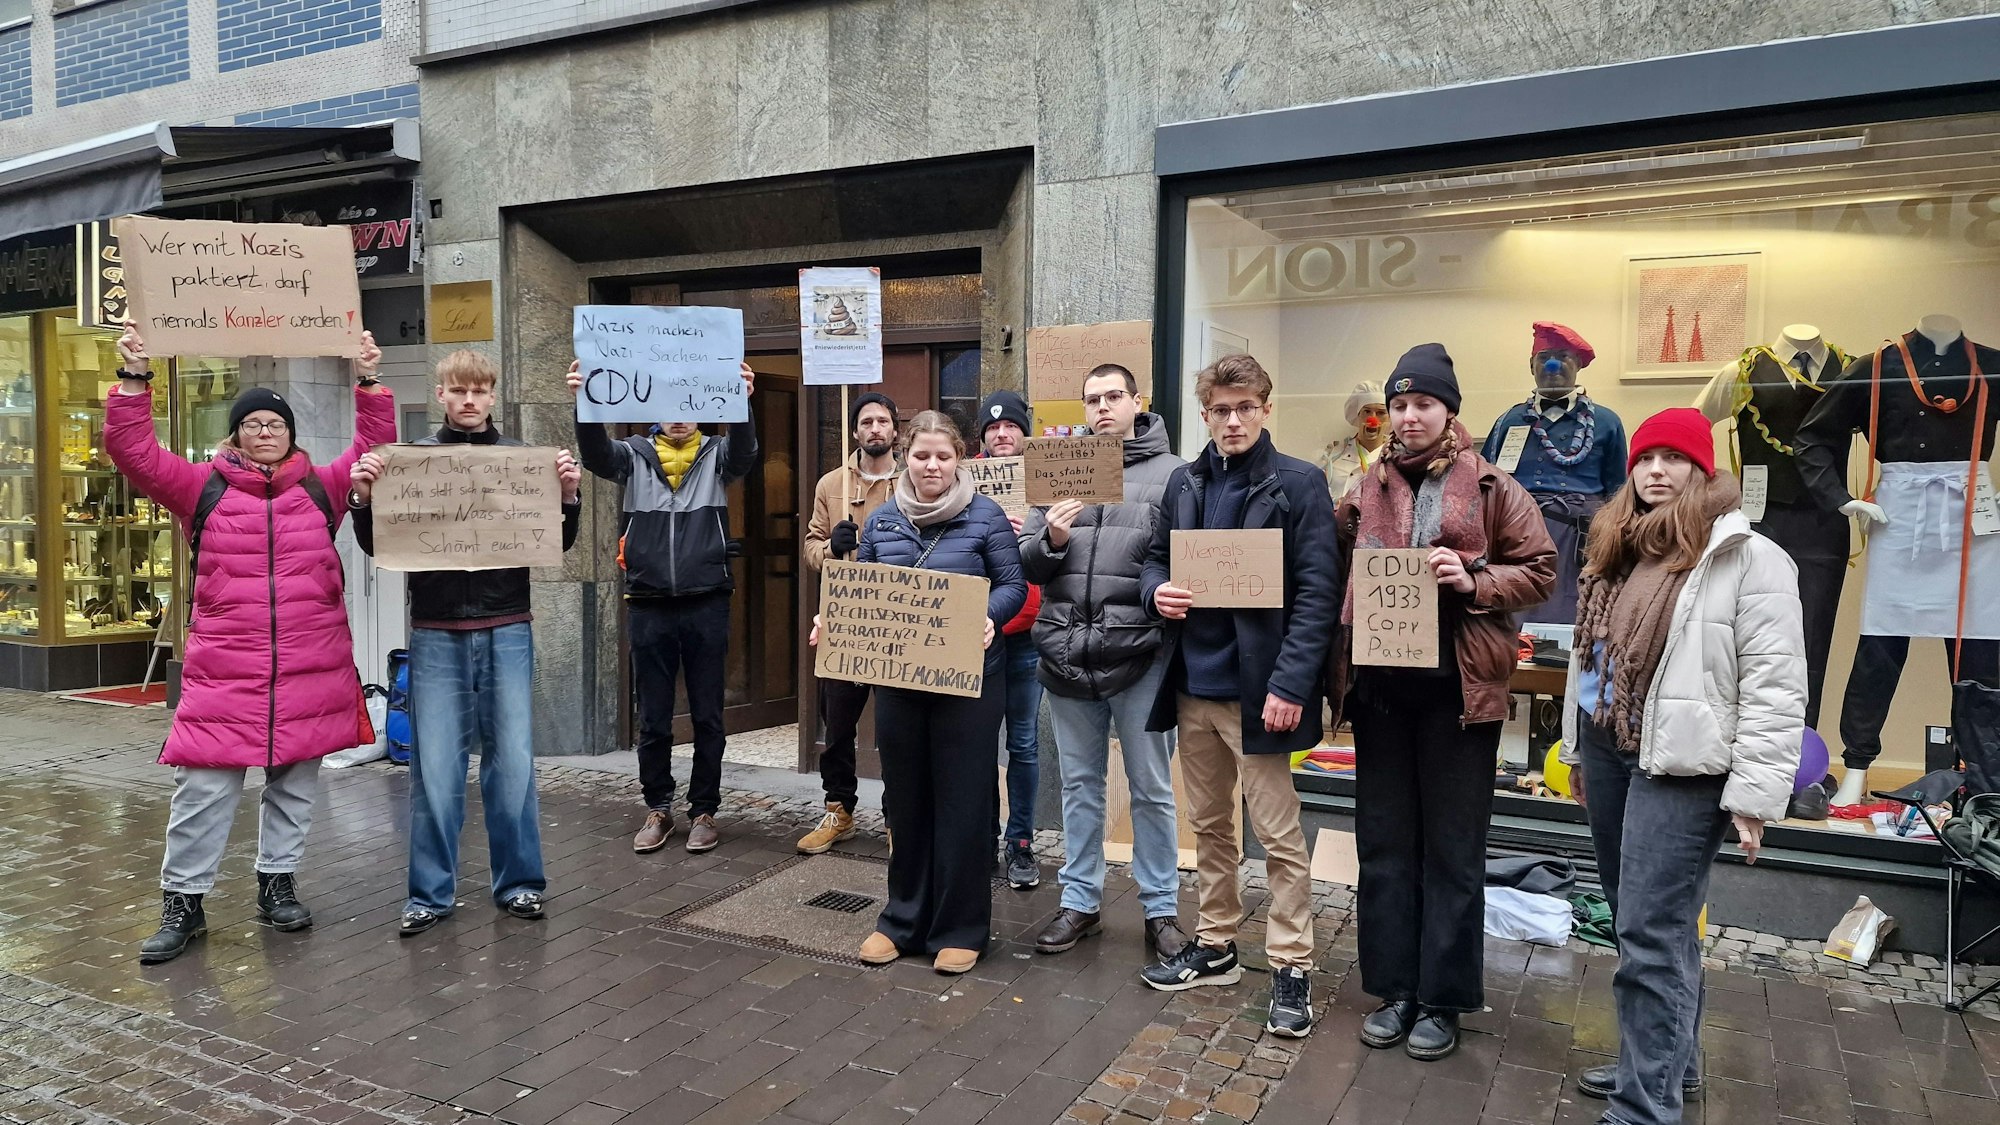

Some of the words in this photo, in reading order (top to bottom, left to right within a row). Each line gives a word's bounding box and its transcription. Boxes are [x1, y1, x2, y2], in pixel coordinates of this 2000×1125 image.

[140, 231, 185, 256] Wer
[192, 231, 235, 256] mit
[241, 232, 304, 258] Nazis
[350, 218, 412, 251] WN
[354, 254, 379, 274] ap
[171, 265, 268, 298] paktiert,
[275, 268, 311, 297] darf
[152, 307, 218, 329] niemals
[225, 305, 286, 329] Kanzler
[289, 305, 355, 335] werden!
[582, 313, 635, 335] Nazis
[648, 324, 704, 338] machen
[584, 367, 652, 406] CDU
[668, 376, 699, 388] was
[1026, 440, 1122, 451] Antifaschistisch
[1044, 450, 1065, 459] seit
[1070, 450, 1095, 459] 1863
[384, 453, 409, 477] Vor
[418, 455, 431, 475] 1
[438, 455, 474, 478] Jahr
[483, 456, 513, 479] auf
[523, 457, 545, 476] der
[969, 461, 1019, 481] HÄMT
[1035, 469, 1054, 479] Das
[1059, 466, 1095, 477] stabile
[459, 481, 477, 495] sich
[1050, 477, 1093, 488] Original
[1052, 489, 1096, 497] SPD/Jusos
[387, 502, 423, 525] jetzt
[430, 505, 447, 521] mit
[454, 503, 494, 522] Nazis
[417, 529, 481, 554] Schämt
[1180, 540, 1244, 560] Niemals
[1216, 558, 1239, 571] mit
[1367, 555, 1428, 577] CDU:
[928, 576, 950, 591] IM
[1180, 575, 1209, 594] der
[1220, 575, 1264, 597] AFD
[887, 591, 946, 610] GEGEN
[1368, 584, 1421, 609] 1933
[826, 601, 951, 629] RECHTSEXTREME
[1367, 613, 1419, 636] Copy
[827, 637, 880, 652] WAREN
[924, 633, 946, 647] ES
[1368, 636, 1423, 660] Paste
